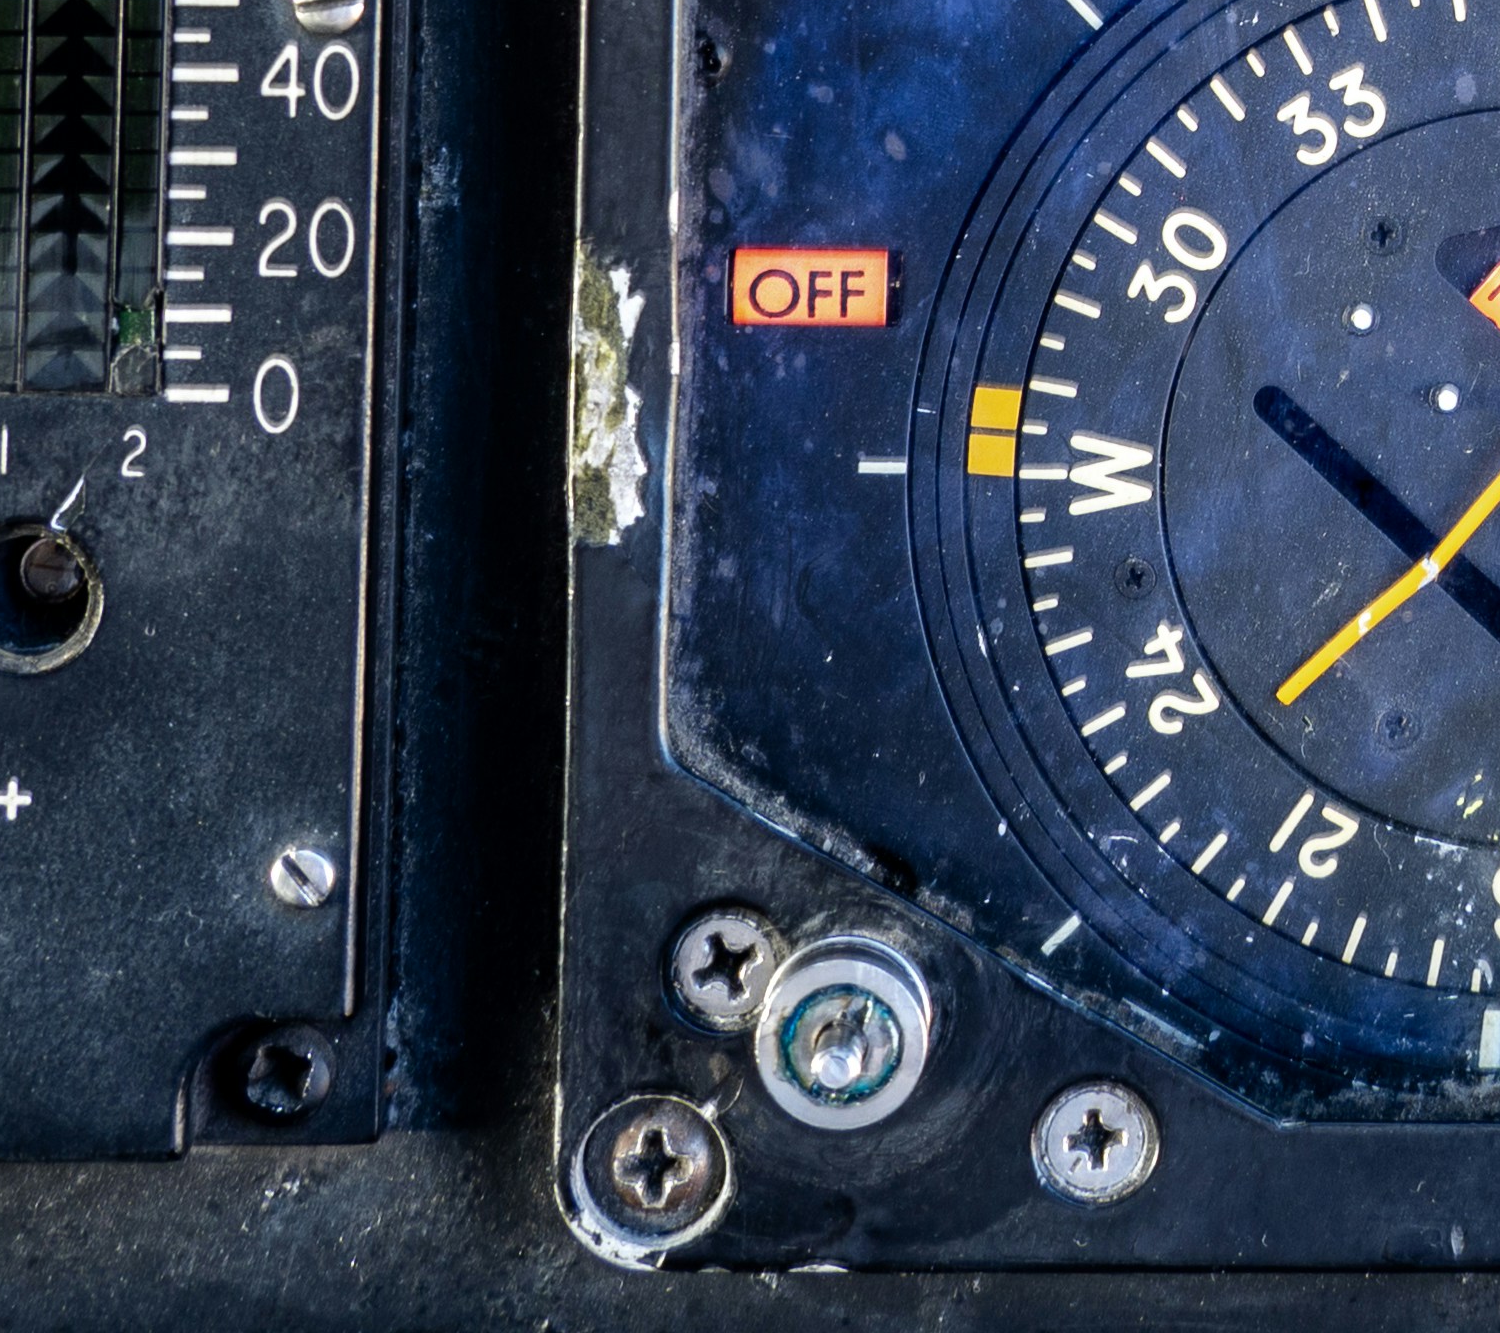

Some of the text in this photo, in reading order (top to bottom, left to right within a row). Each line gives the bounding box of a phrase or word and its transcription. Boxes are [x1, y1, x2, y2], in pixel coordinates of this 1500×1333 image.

[260, 43, 360, 121] 40
[1276, 63, 1386, 165] 33
[257, 201, 355, 279] 20
[1127, 208, 1228, 323] 30
[749, 269, 864, 318] OFF
[253, 355, 299, 434] 0
[122, 426, 147, 477] 2
